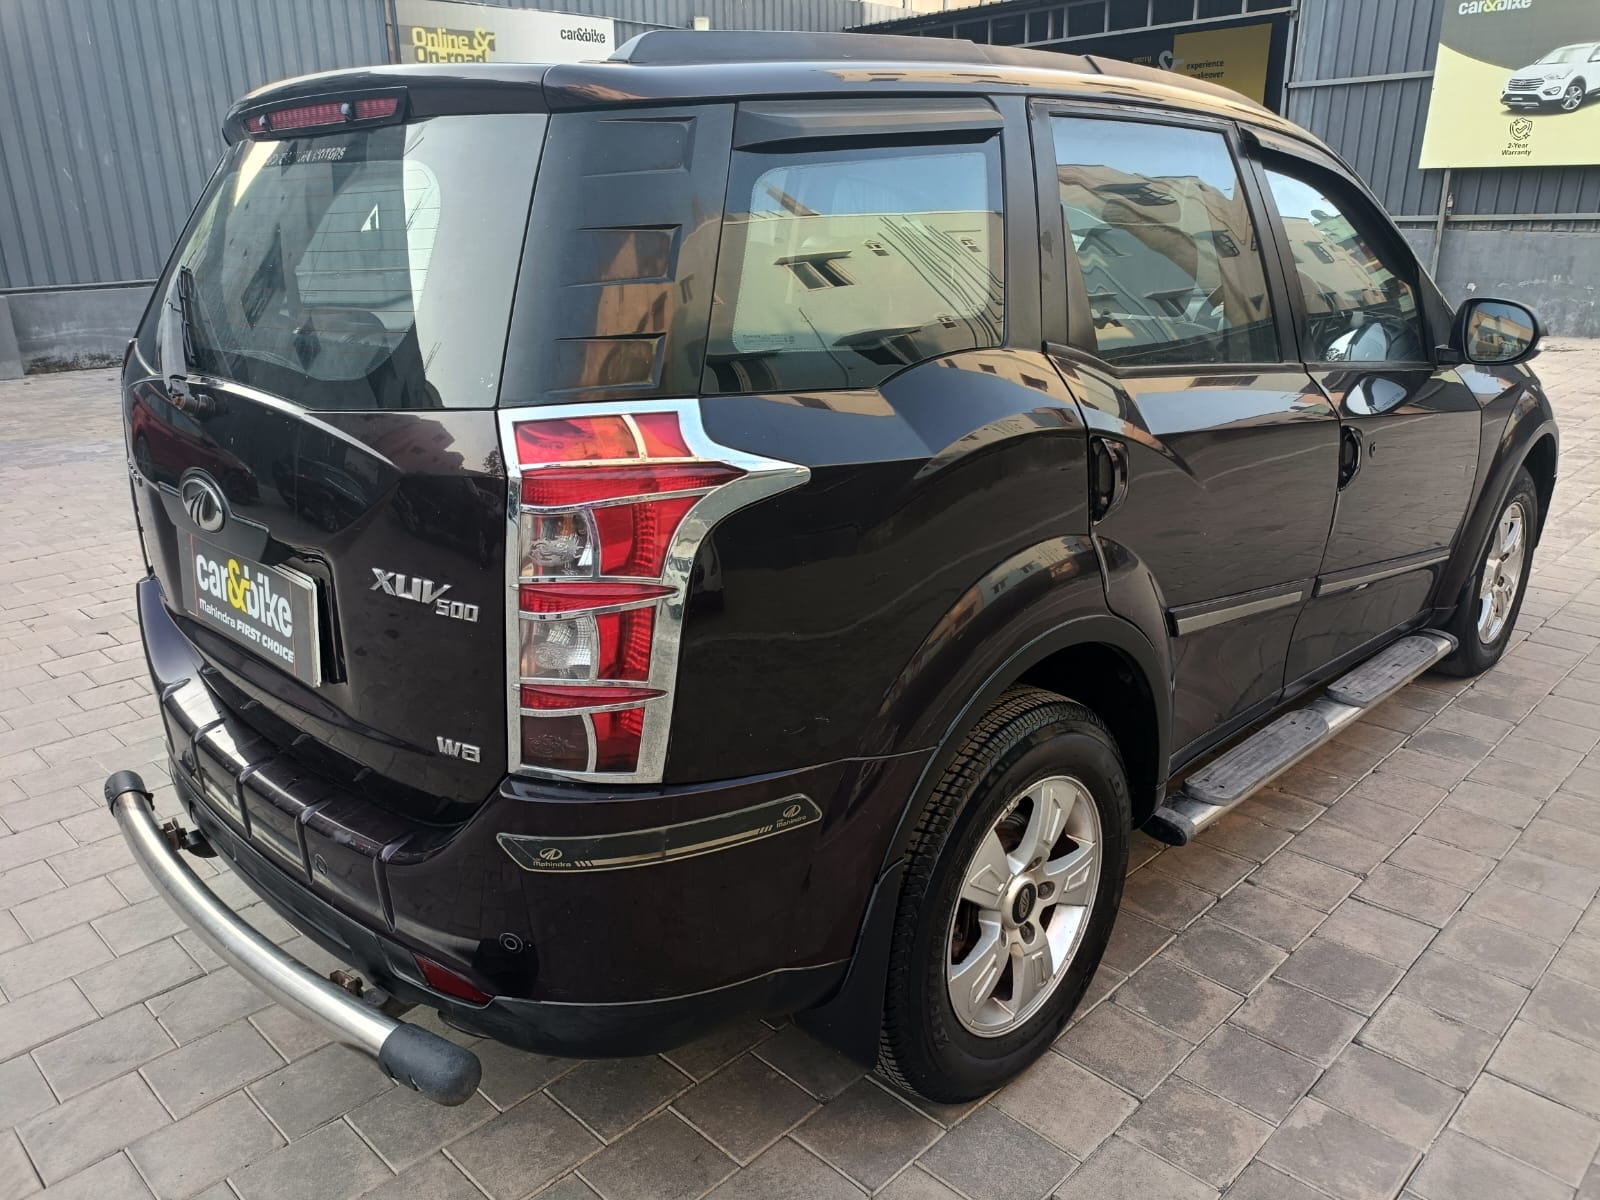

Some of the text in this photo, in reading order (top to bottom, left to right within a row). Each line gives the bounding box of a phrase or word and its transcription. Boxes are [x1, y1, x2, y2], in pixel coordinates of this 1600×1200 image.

[412, 27, 495, 51] Online &
[560, 27, 606, 44] car&bike
[415, 45, 487, 63] On-road
[1186, 59, 1225, 71] experience
[1501, 149, 1532, 157] Warranty
[196, 554, 293, 638] car&bike
[236, 619, 261, 643] FIRST
[261, 634, 294, 664] CHOICE
[436, 735, 481, 763] W8
